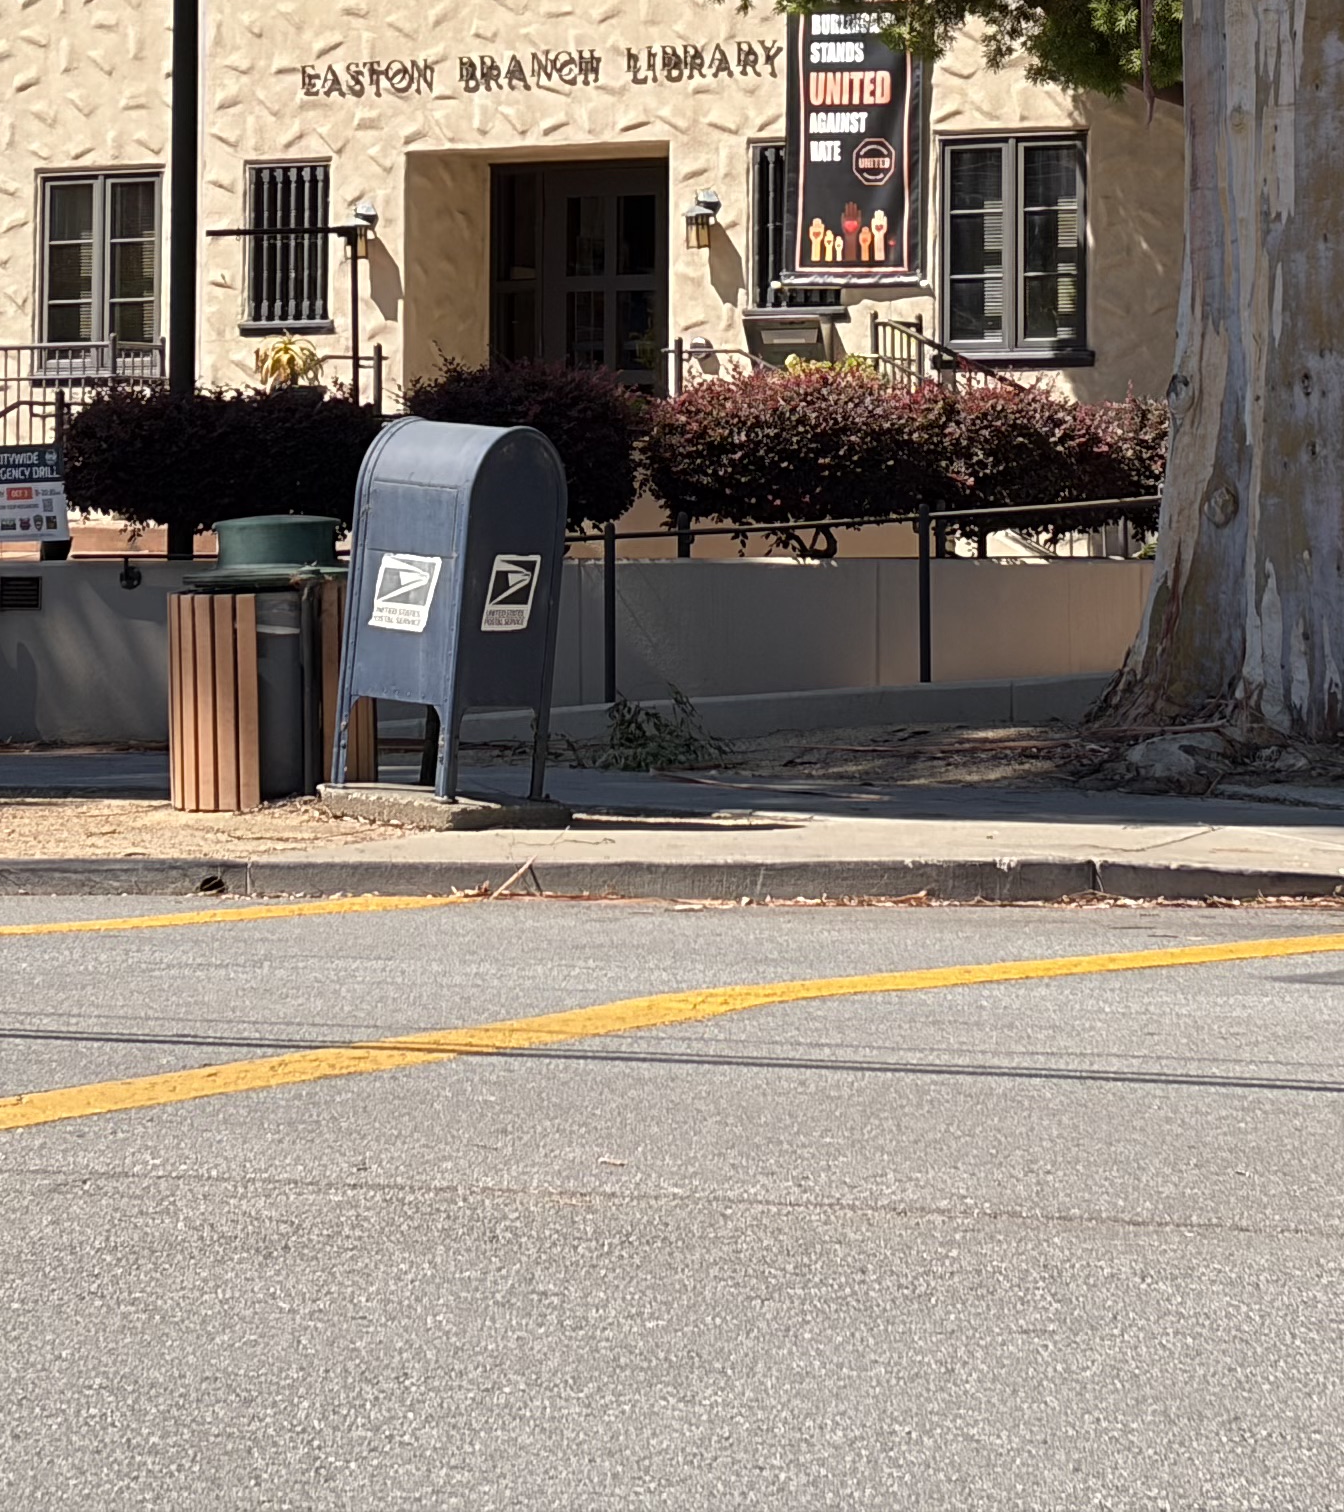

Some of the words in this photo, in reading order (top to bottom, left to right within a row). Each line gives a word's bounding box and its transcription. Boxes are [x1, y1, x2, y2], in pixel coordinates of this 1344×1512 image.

[810, 42, 864, 63] STANDS
[301, 59, 433, 94] EASTON
[458, 48, 600, 90] BRANCH
[626, 40, 782, 81] LIBRARY
[809, 70, 892, 106] UNITED
[809, 112, 868, 133] AGAINST
[810, 140, 842, 162] HATE
[858, 157, 890, 169] UNITED
[32, 466, 60, 478] DRILL
